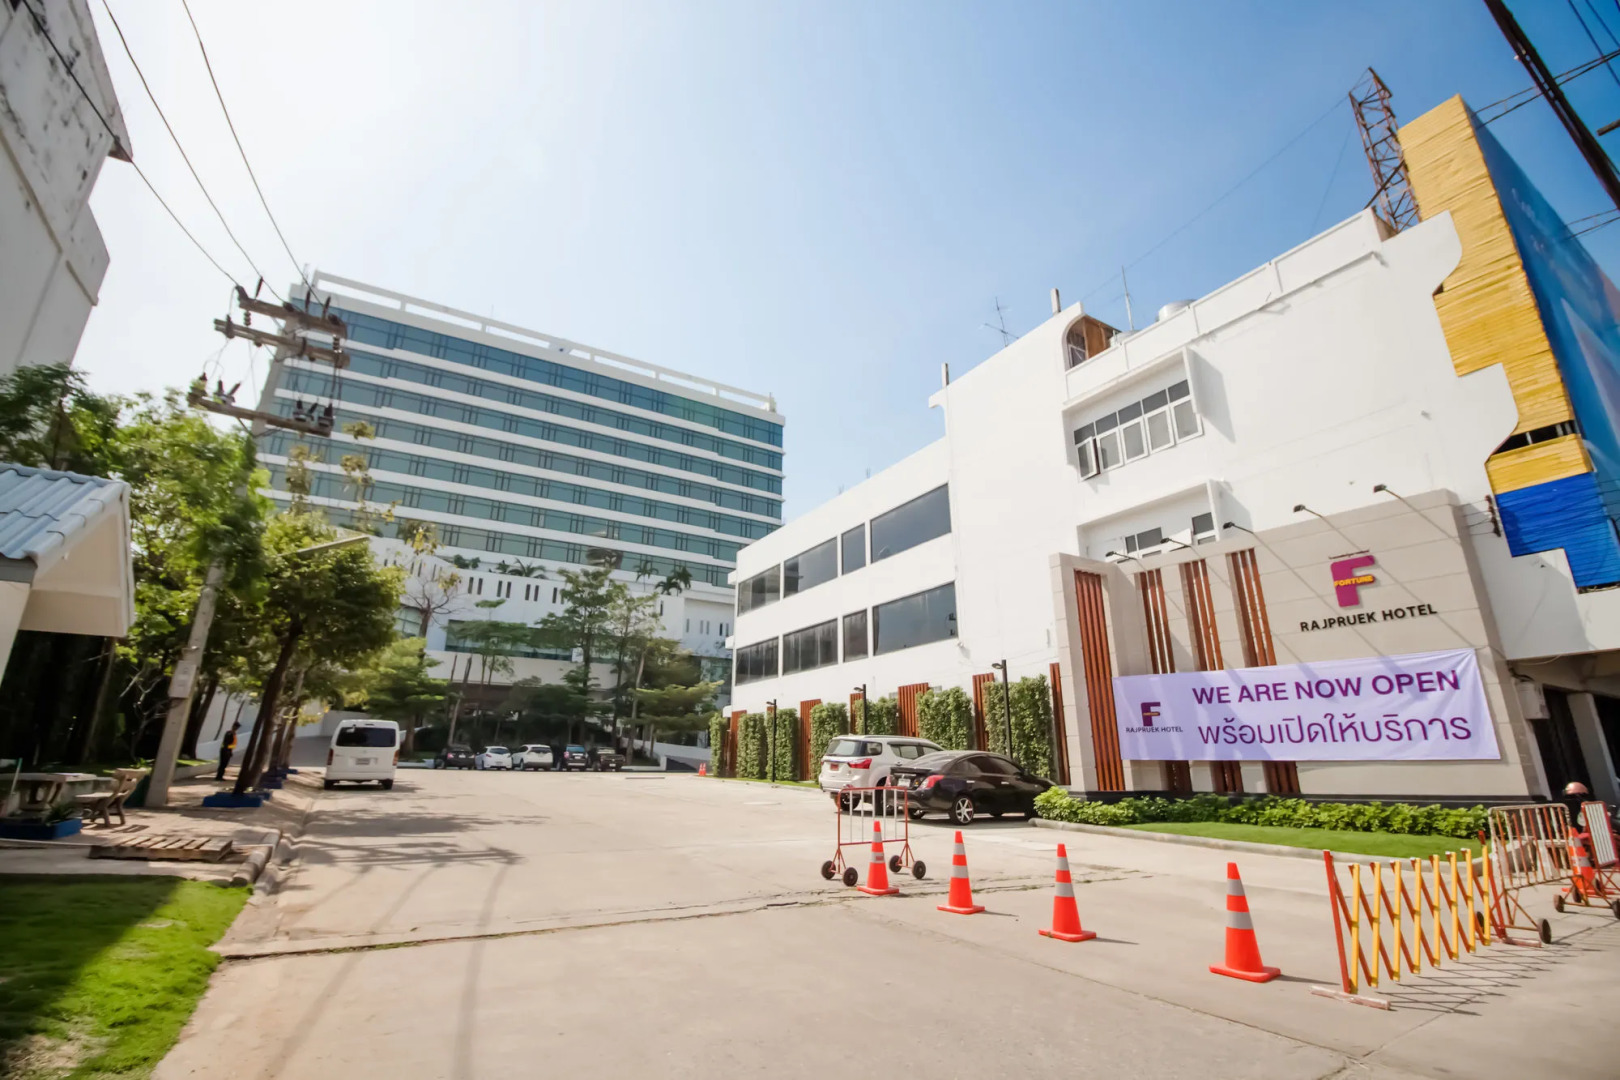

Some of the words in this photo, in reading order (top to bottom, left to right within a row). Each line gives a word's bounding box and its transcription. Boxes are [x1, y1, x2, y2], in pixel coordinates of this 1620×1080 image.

[1331, 555, 1376, 607] F
[1300, 611, 1377, 632] RAJPRUEK
[1382, 604, 1437, 621] HOTEL
[1192, 687, 1231, 704] WE
[1238, 682, 1289, 702] ARE
[1294, 677, 1362, 699] NOW
[1372, 670, 1460, 695] OPEN
[1198, 713, 1472, 744] พร้อมเปิดให้บริการ
